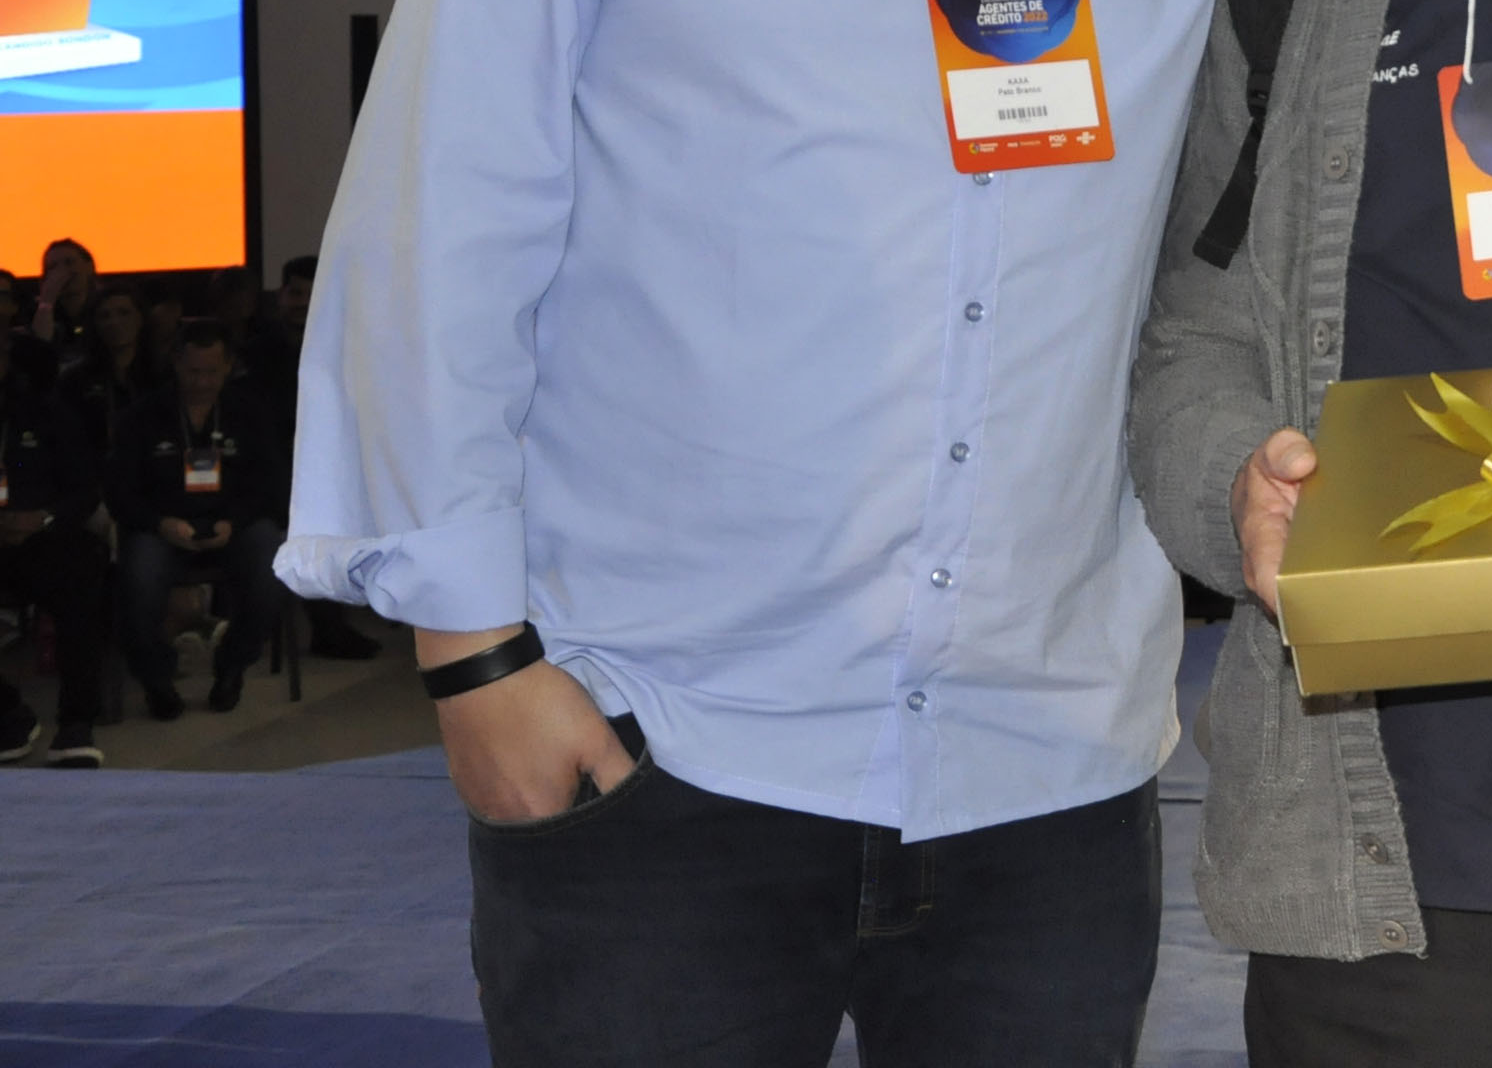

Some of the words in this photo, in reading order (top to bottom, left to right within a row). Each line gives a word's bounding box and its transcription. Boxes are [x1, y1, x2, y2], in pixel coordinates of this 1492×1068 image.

[979, 0, 1027, 14] AGENTES
[1028, 0, 1044, 11] DE
[1372, 63, 1419, 84] ANÇAS
